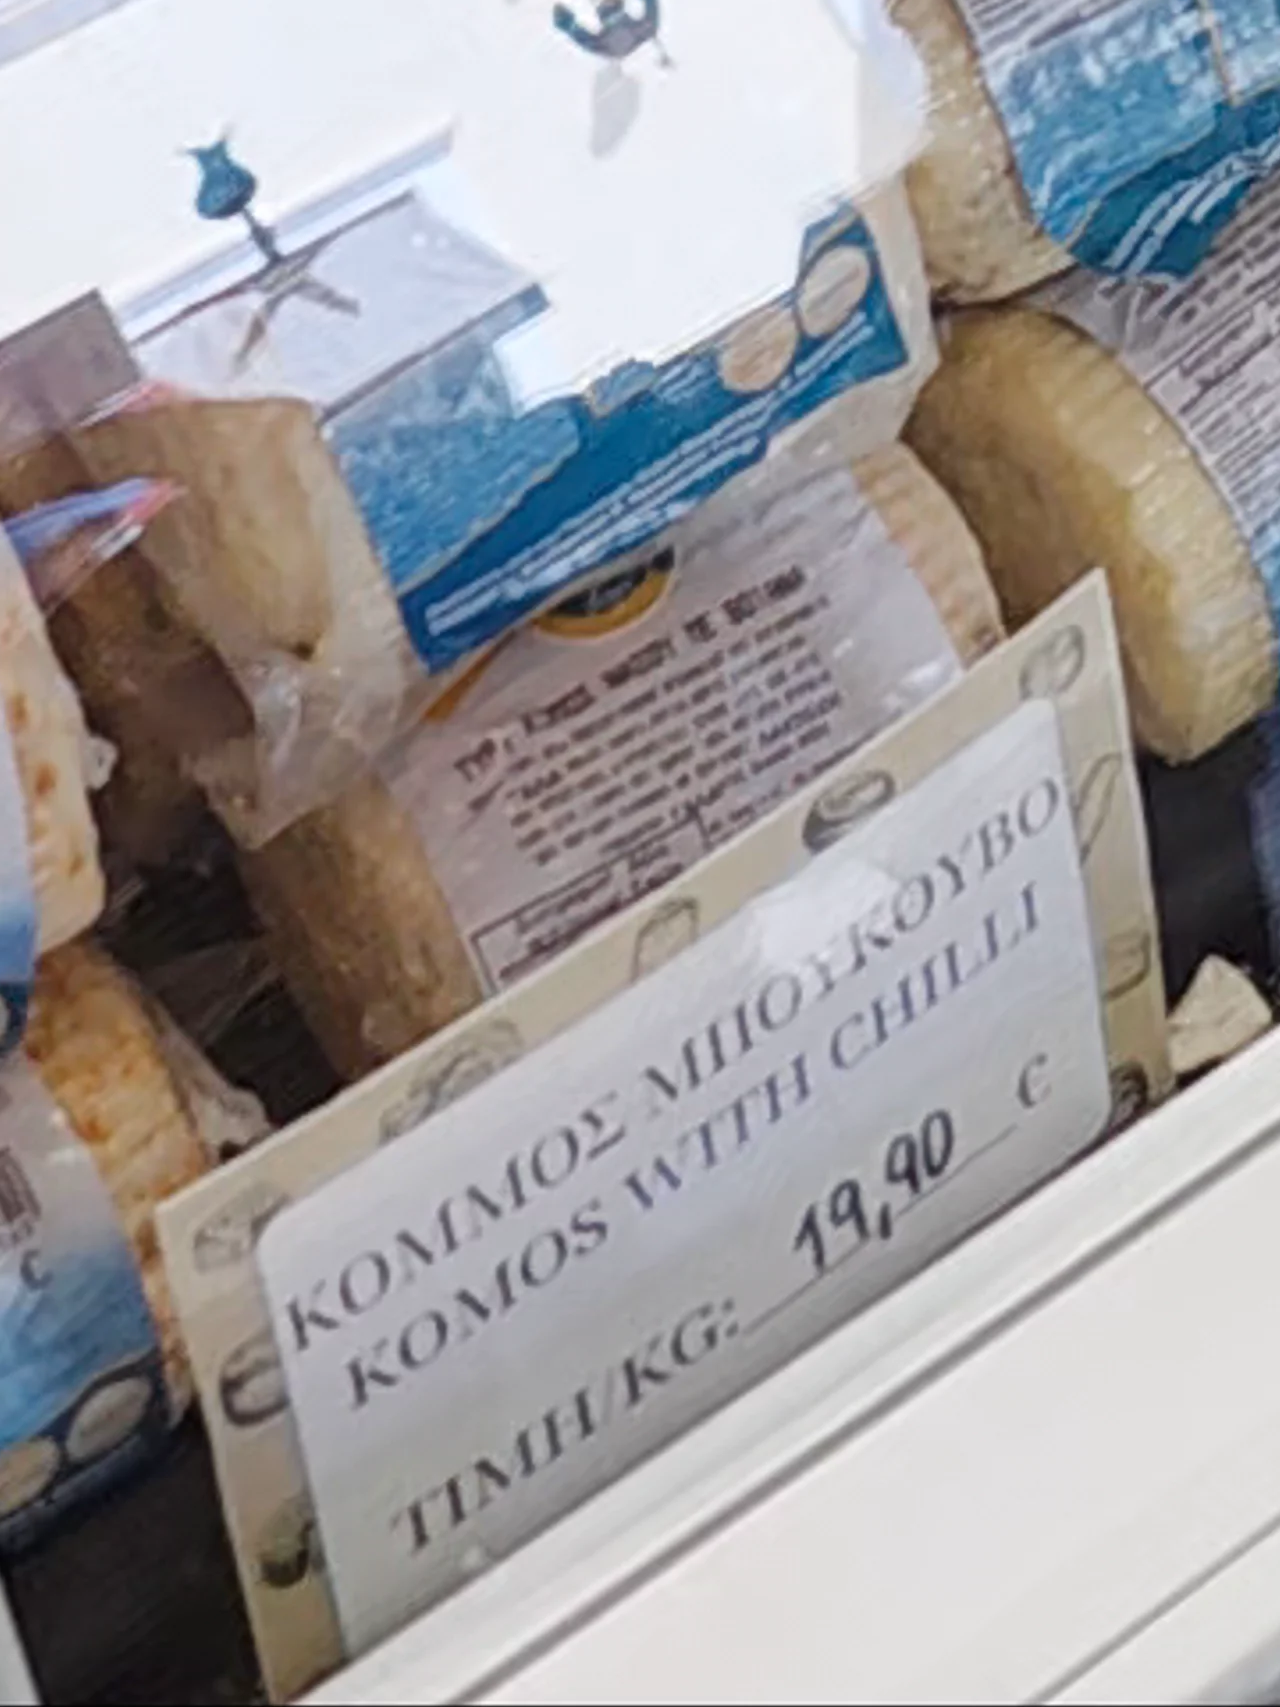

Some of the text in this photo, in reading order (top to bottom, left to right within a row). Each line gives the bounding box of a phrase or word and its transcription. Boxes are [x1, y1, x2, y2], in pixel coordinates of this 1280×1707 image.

[284, 1090, 627, 1353] ΚΟΜΜΟΣ
[344, 879, 1040, 1411] KOMOS WITH CHILLI
[792, 1107, 956, 1269] 19,90
